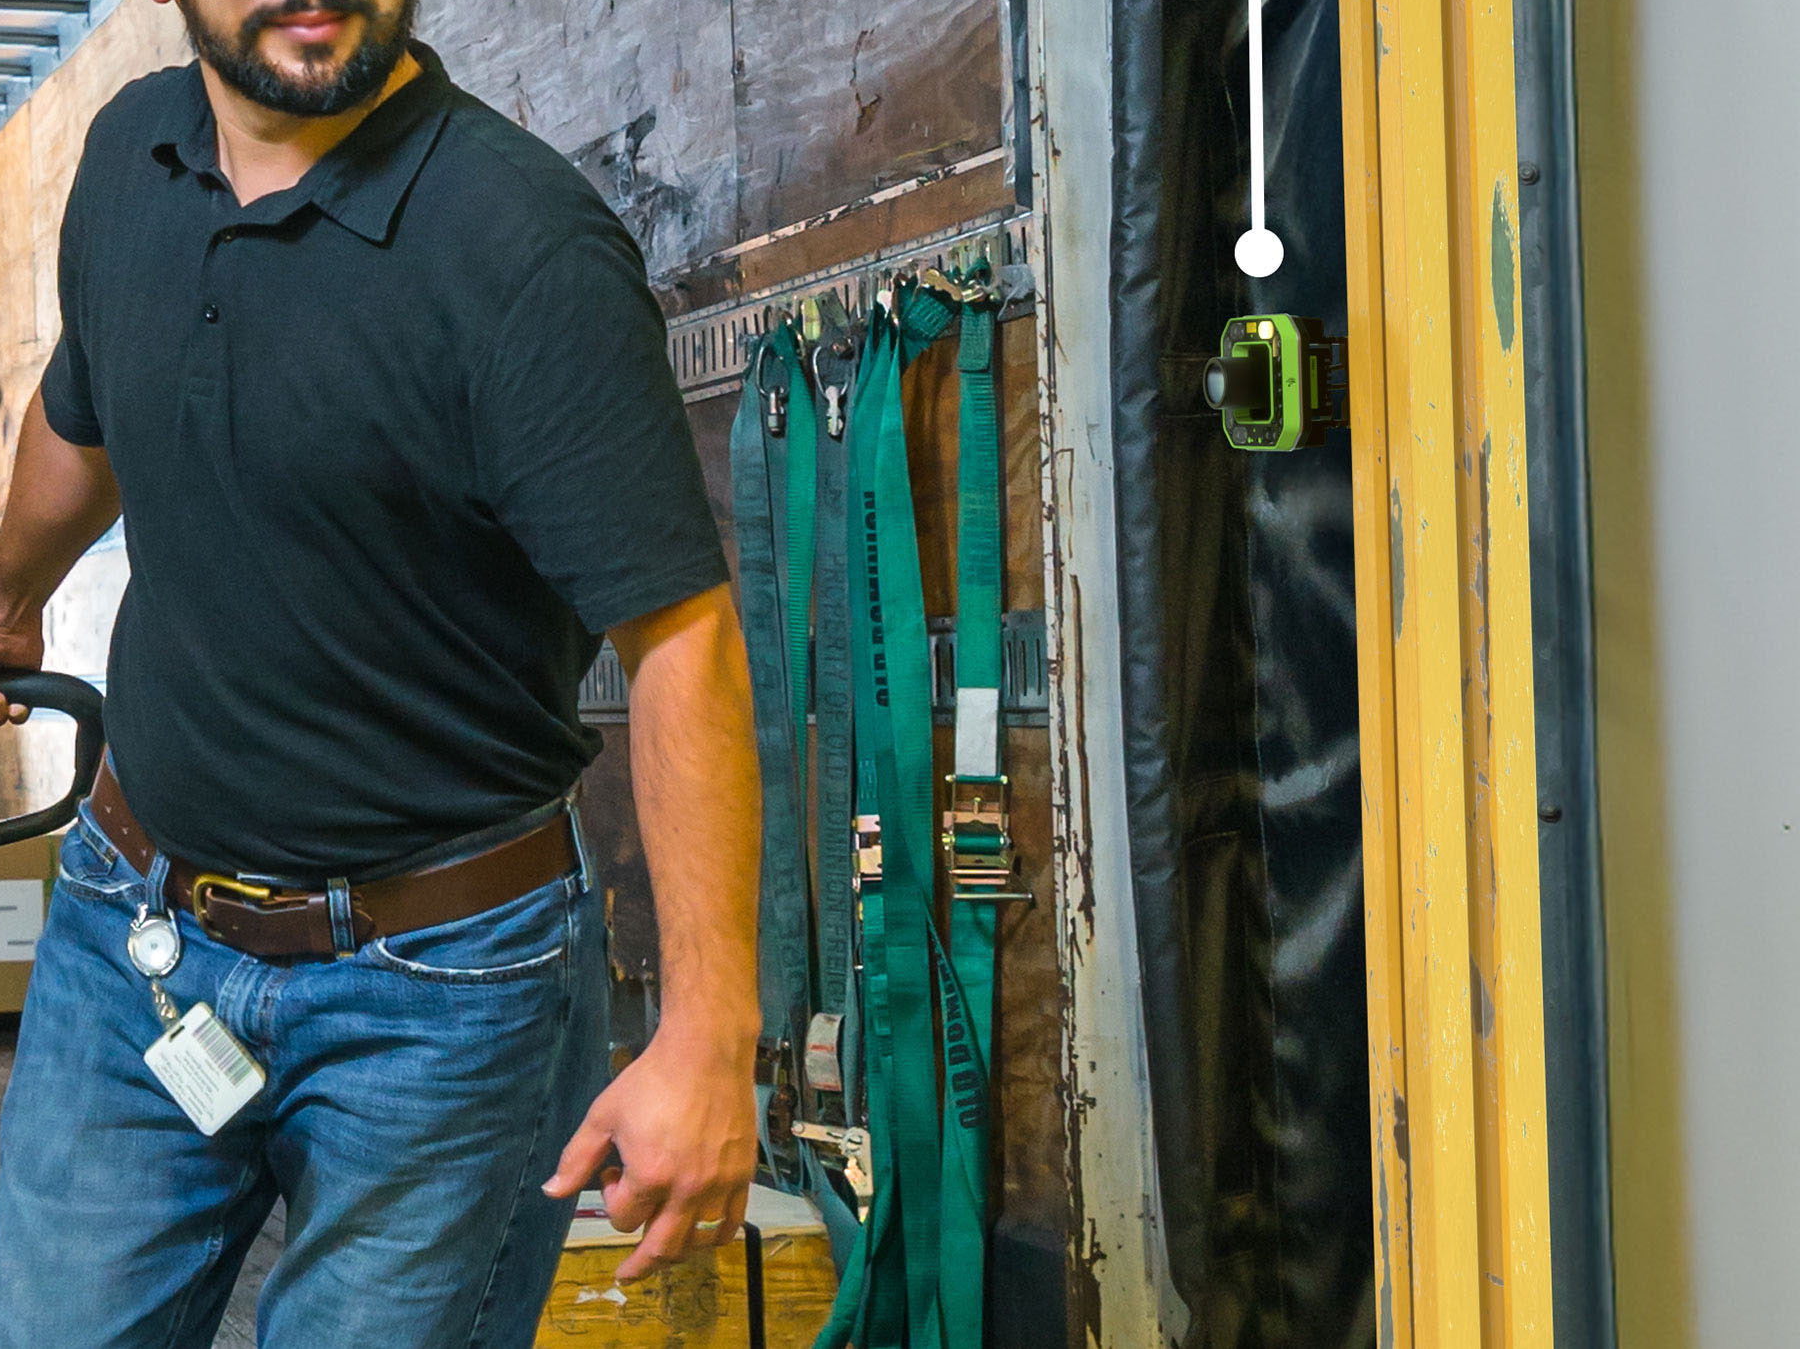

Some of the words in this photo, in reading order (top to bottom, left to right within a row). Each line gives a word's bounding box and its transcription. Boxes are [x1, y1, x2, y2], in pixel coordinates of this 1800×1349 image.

[821, 553, 848, 682] PROPERTY
[823, 690, 848, 723] OF
[824, 733, 848, 780] OLD
[825, 791, 848, 913] DOMINION
[952, 1069, 989, 1129] OLD
